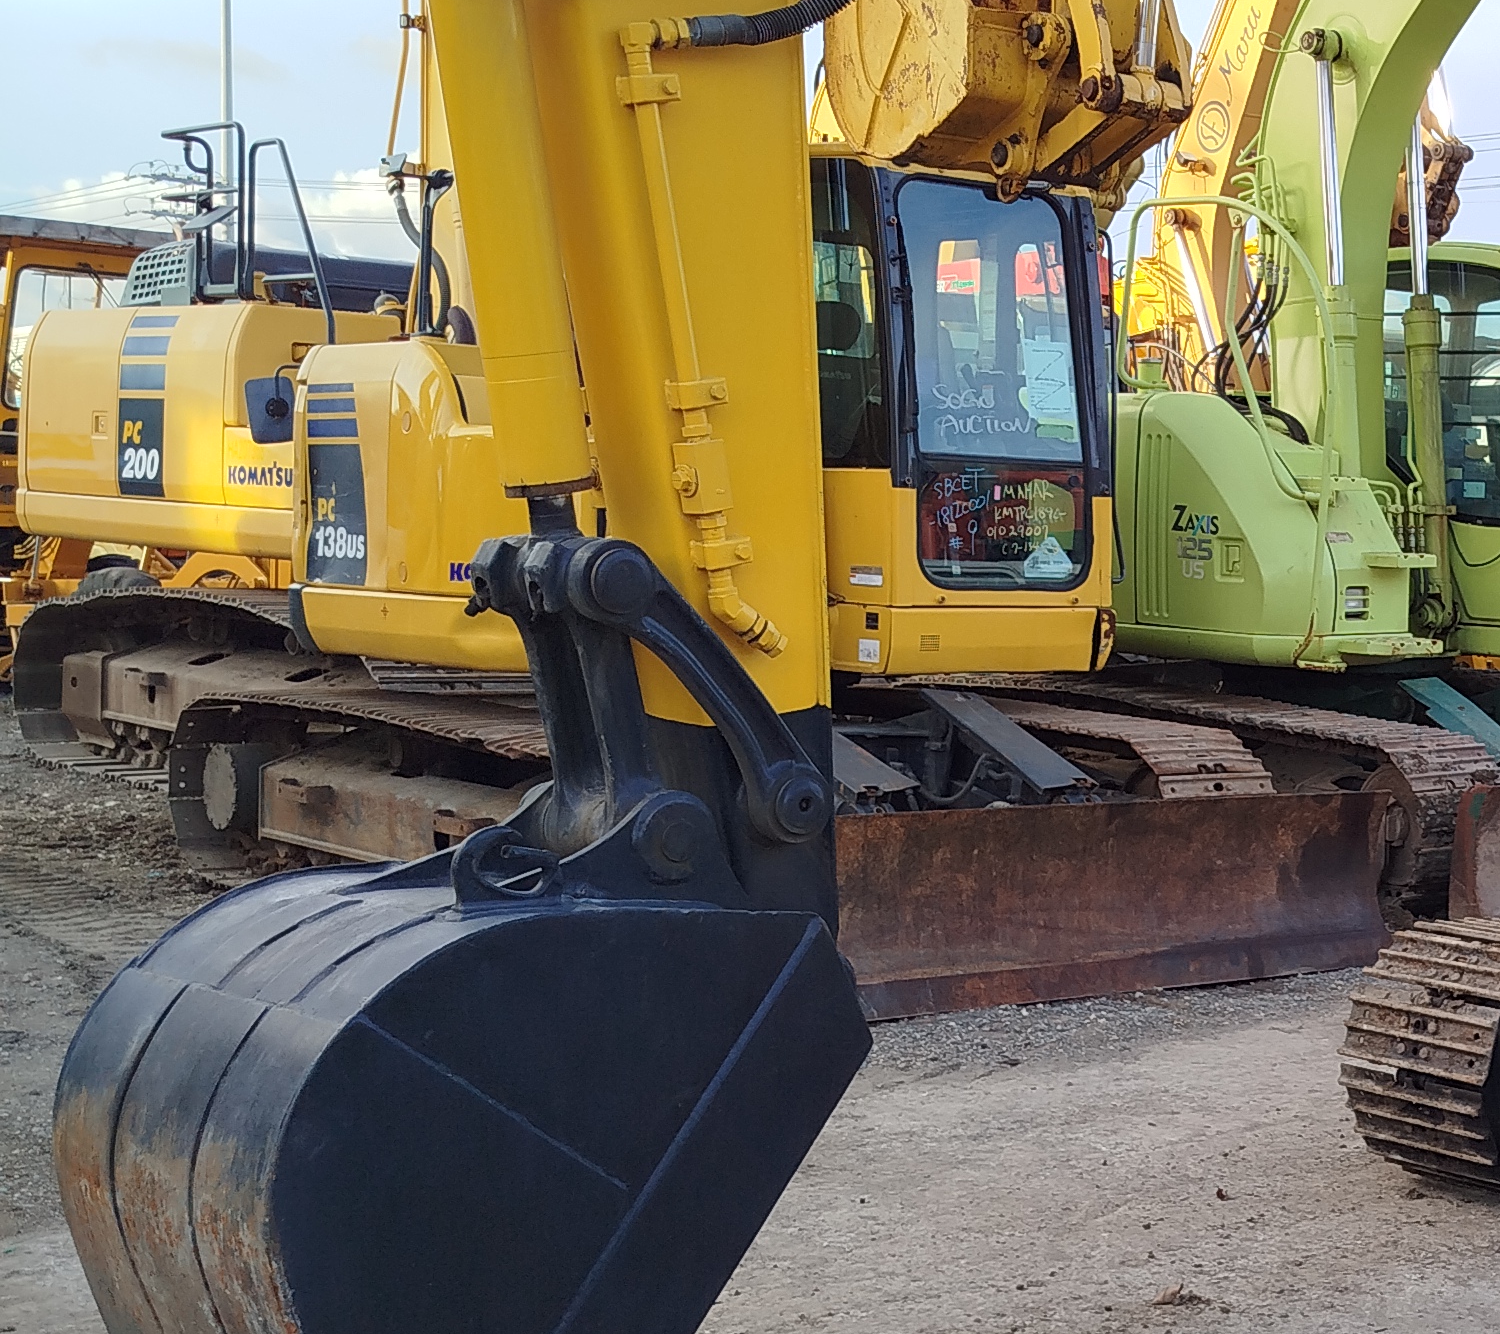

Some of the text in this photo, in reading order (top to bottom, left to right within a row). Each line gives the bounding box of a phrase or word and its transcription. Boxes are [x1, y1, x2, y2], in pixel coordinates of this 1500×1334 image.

[122, 420, 143, 444] PC
[122, 447, 160, 480] 200
[228, 461, 293, 488] KOMATSU
[317, 497, 336, 522] PC
[1171, 504, 1219, 536] ZAXIS
[1176, 536, 1213, 560] 125
[1182, 560, 1205, 579] US
